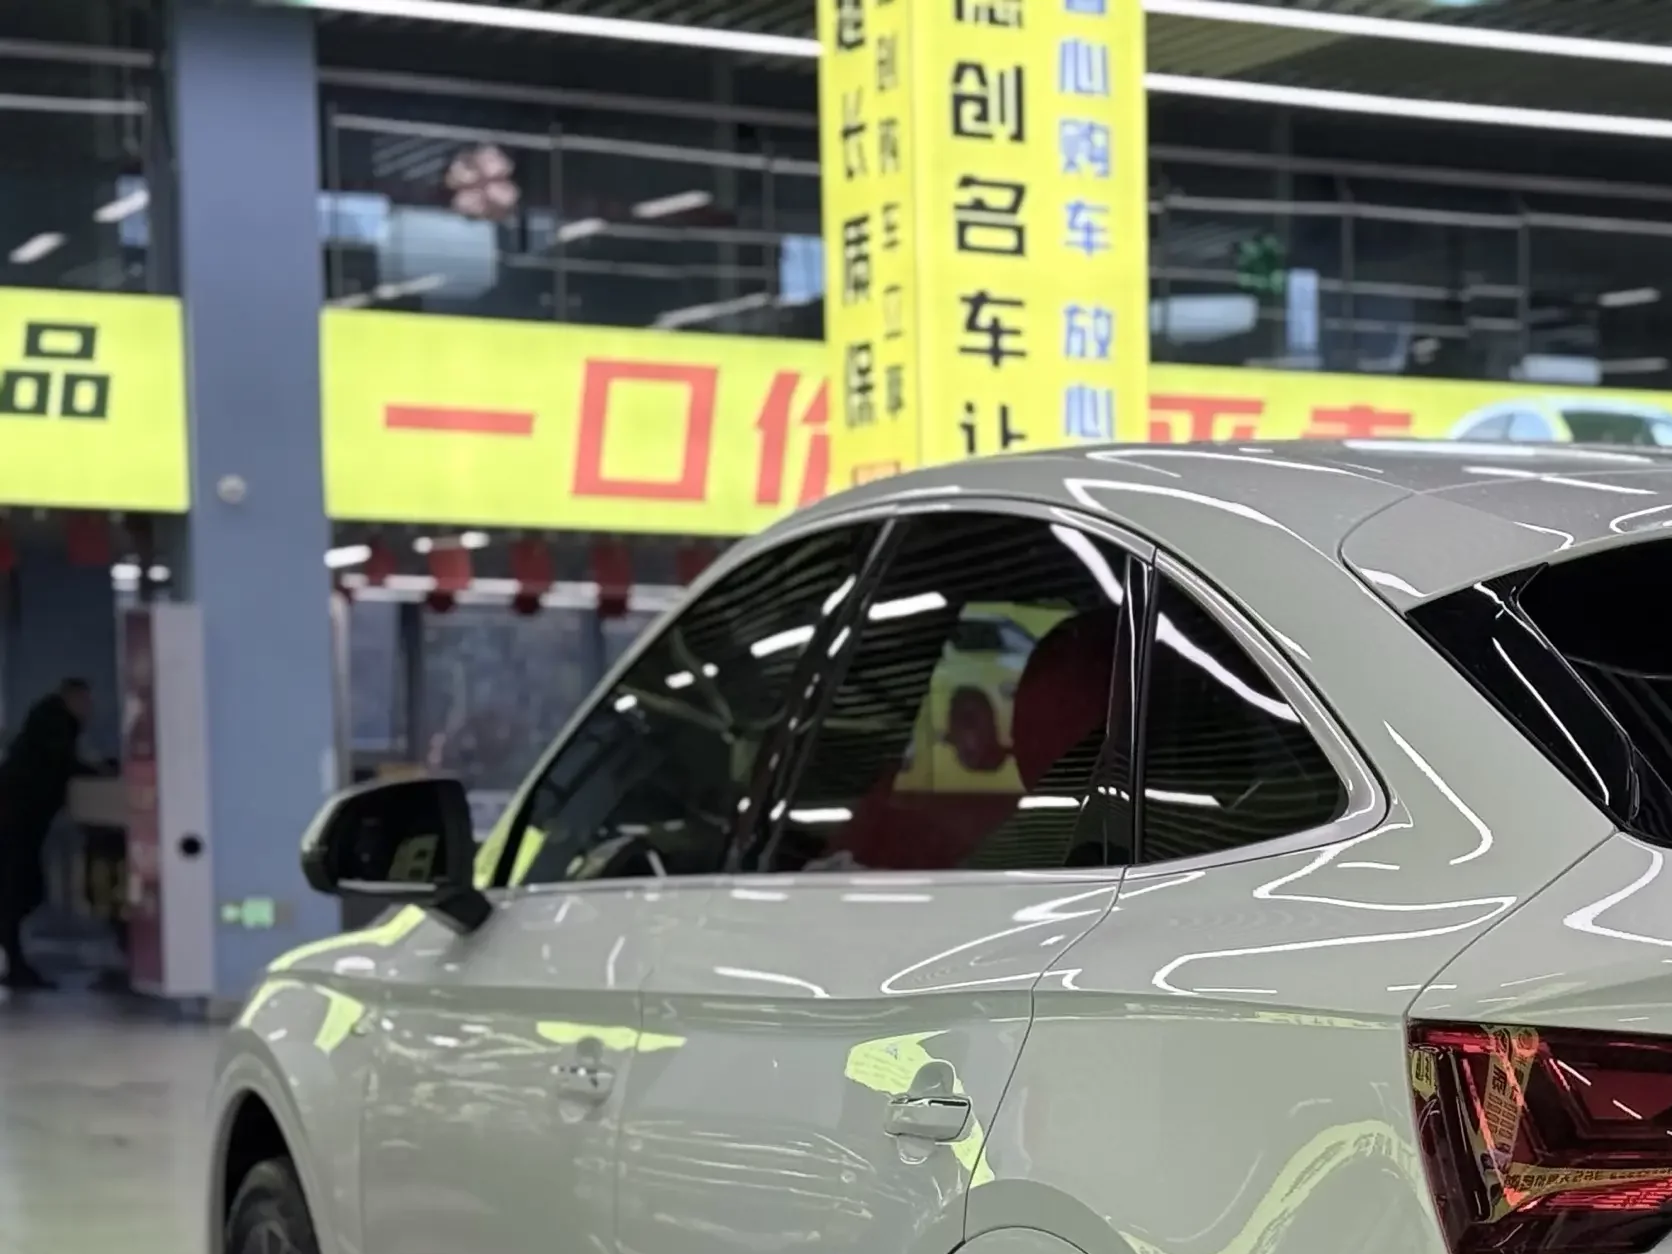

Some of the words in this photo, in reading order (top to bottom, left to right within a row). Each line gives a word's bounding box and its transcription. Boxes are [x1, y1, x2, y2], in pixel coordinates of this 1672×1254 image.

[1058, 0, 1115, 439] 心购车放心
